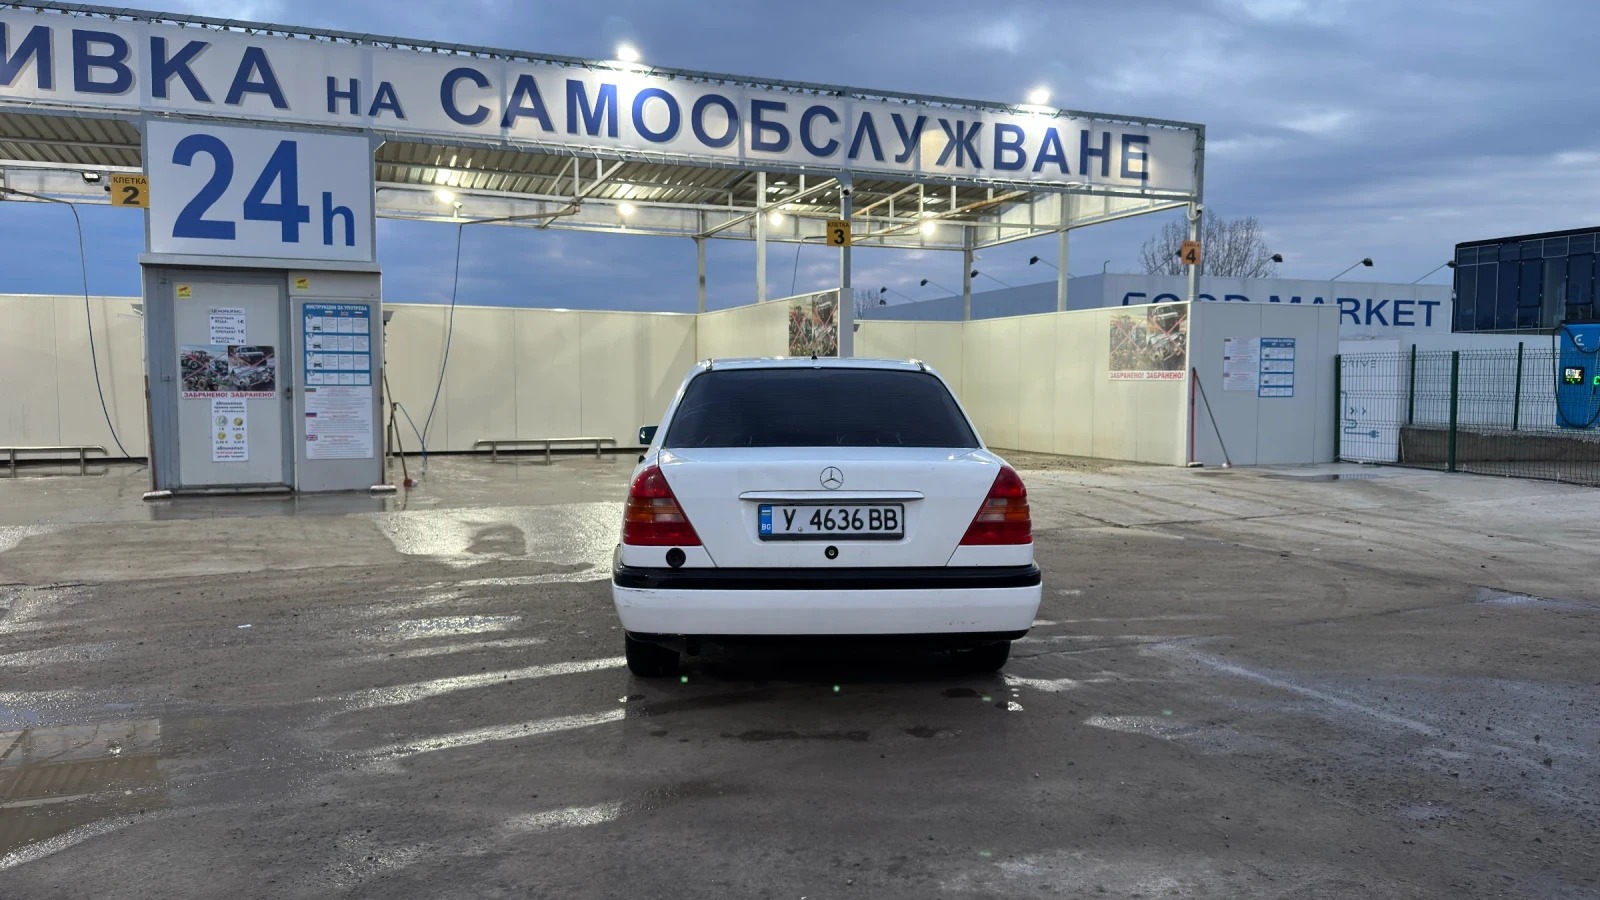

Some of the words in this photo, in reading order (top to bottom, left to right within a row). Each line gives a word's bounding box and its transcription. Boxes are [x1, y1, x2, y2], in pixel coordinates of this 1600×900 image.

[0, 22, 288, 109] ИВКА
[327, 76, 404, 118] НА
[439, 67, 1149, 180] САМООБСЛУЖВАНЕ
[113, 176, 147, 185] КЛЕТКА
[122, 185, 140, 205] 2
[833, 229, 845, 245] 3
[1185, 248, 1197, 264] 4
[1269, 295, 1441, 327] RKET
[1109, 371, 1144, 379] ЗАБРАНЕНО!
[1146, 371, 1184, 380] ЗАБРАНЕНО!
[761, 523, 772, 531] BG
